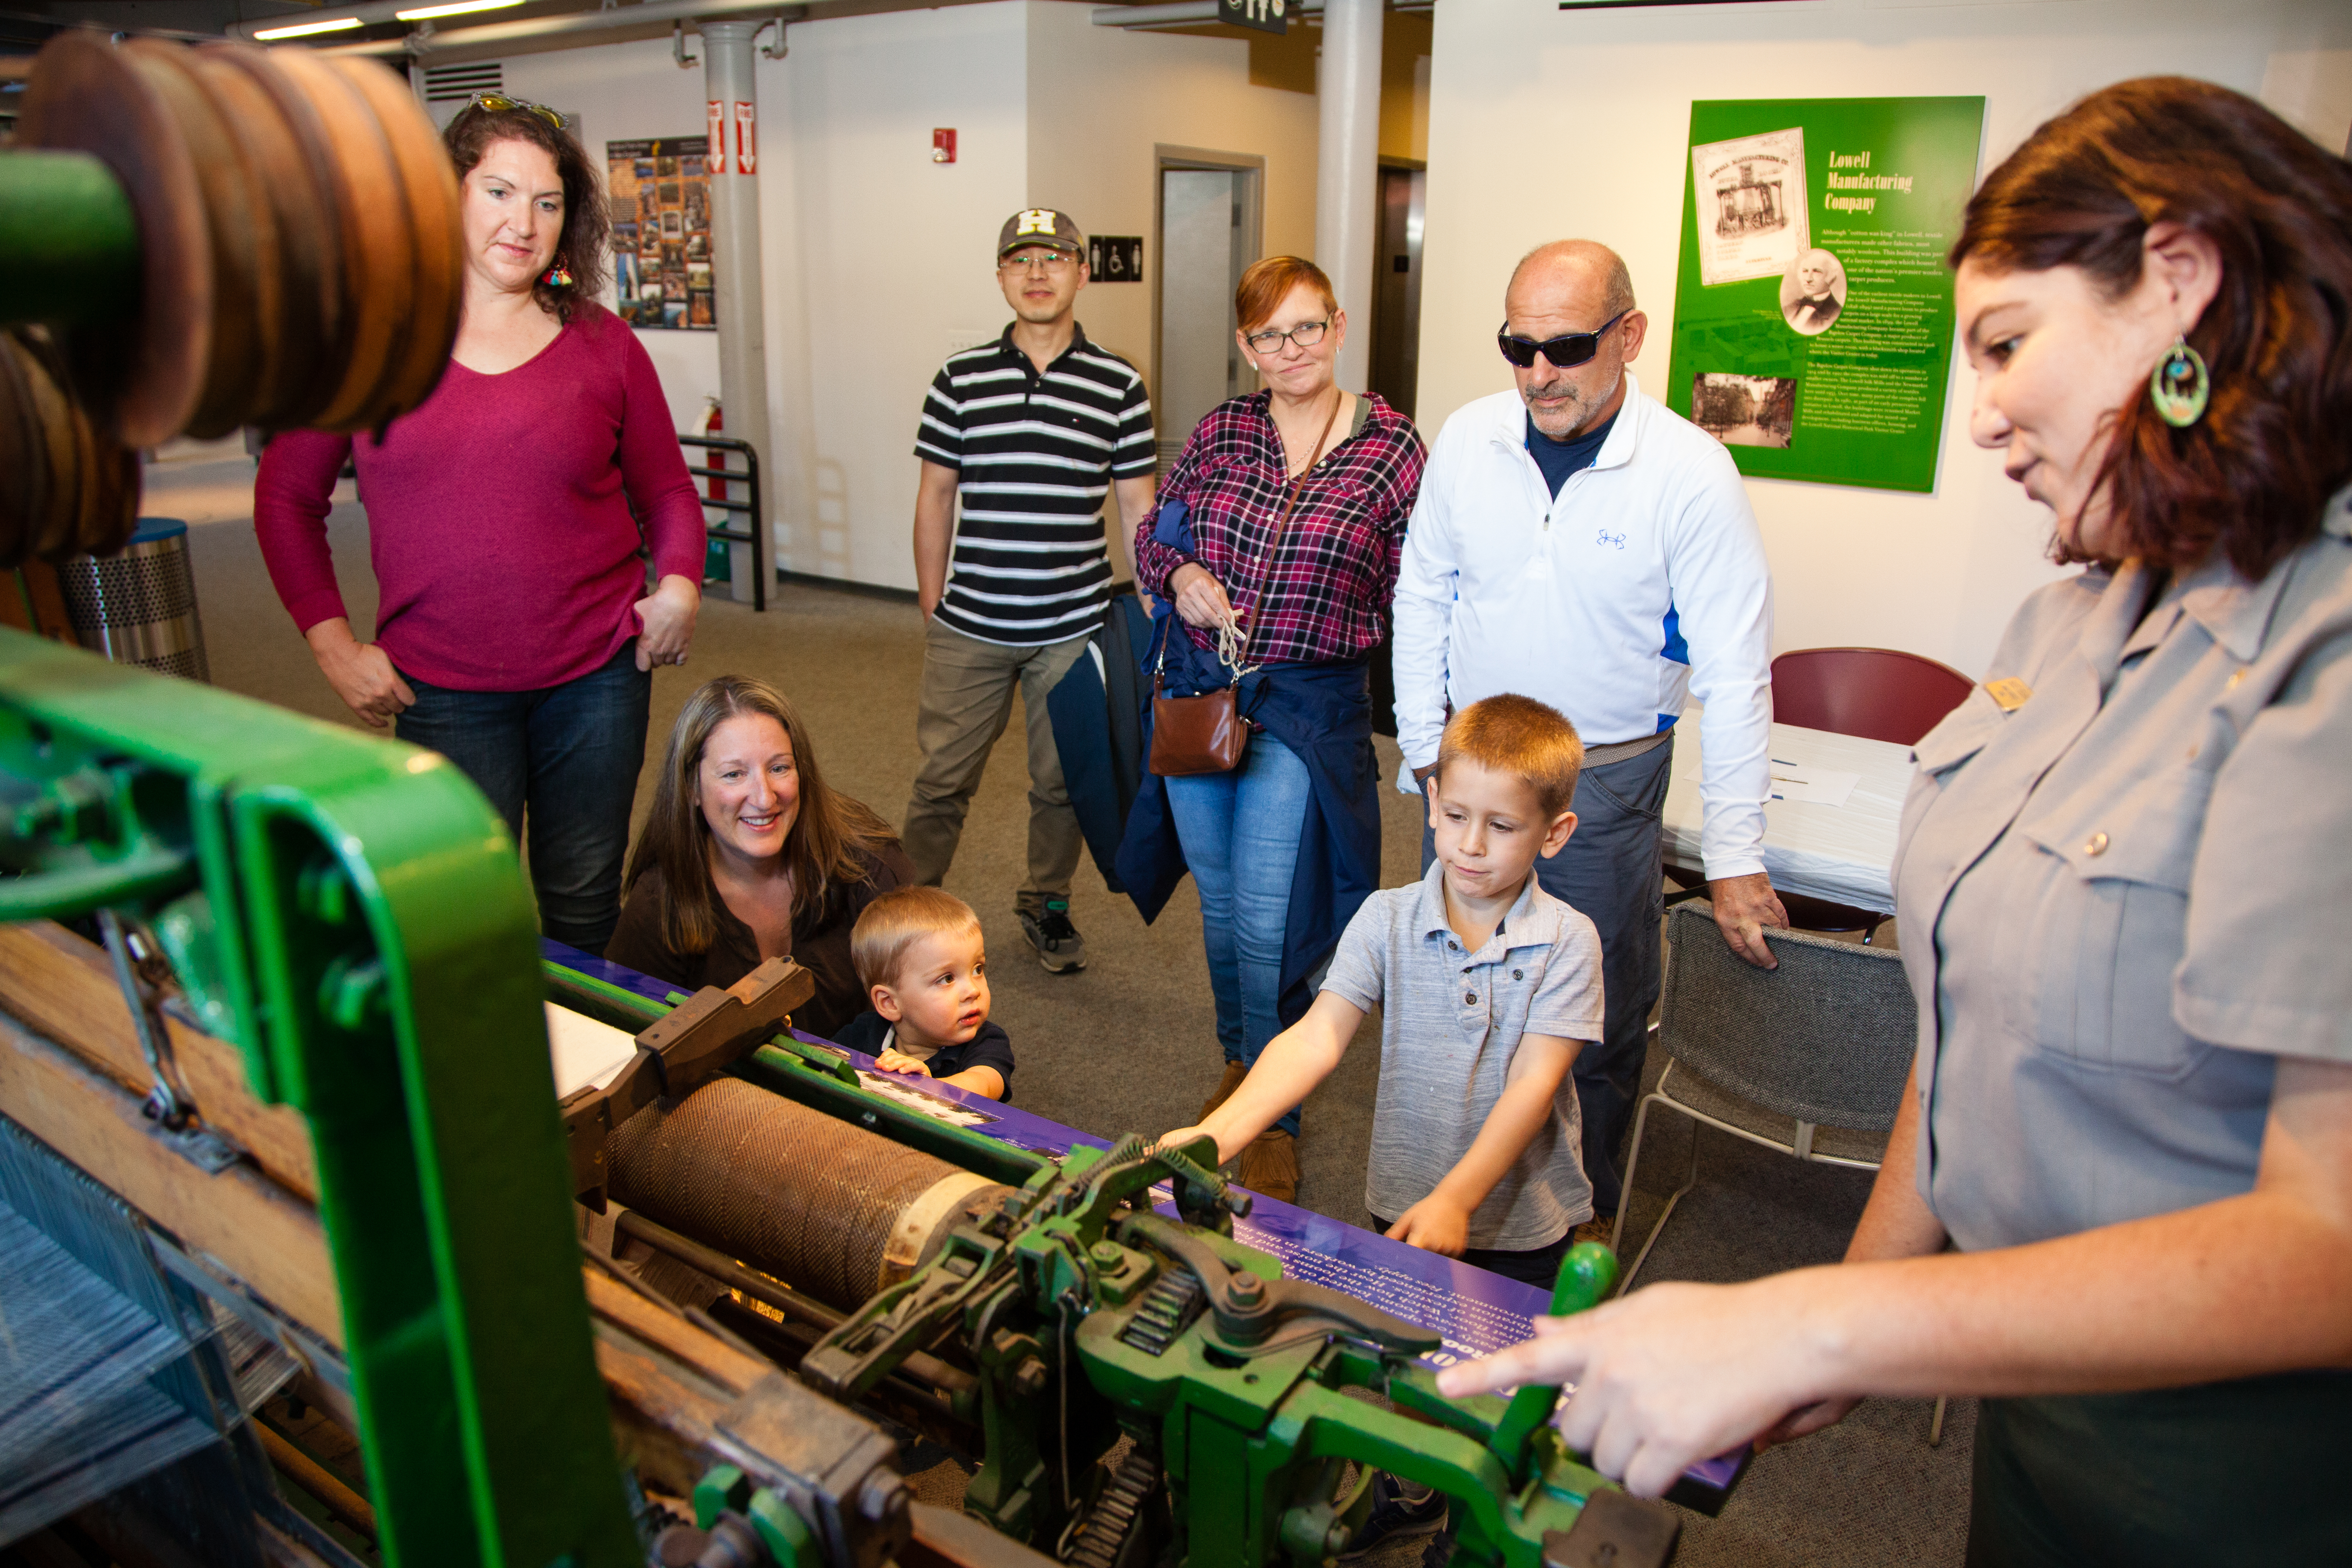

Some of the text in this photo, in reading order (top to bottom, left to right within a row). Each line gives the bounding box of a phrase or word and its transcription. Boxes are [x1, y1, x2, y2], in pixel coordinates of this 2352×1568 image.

[1829, 151, 1870, 168] Lowell
[1826, 172, 1912, 193] Manufacturing
[1825, 192, 1876, 216] Company
[1232, 1230, 1254, 1240] fee
[1255, 1231, 1282, 1243] this
[1249, 1243, 1290, 1259] weave
[1256, 1238, 1283, 1250] and
[1284, 1248, 1322, 1264] noise
[1301, 1247, 1356, 1269] workers
[1279, 1261, 1295, 1270] th
[1292, 1259, 1336, 1277] looms
[1297, 1268, 1317, 1277] on
[1324, 1263, 1348, 1274] the
[1358, 1266, 1376, 1276] by
[1317, 1276, 1371, 1298] located
[1338, 1275, 1362, 1286] the
[1350, 1272, 1386, 1287] Hear
[1415, 1280, 1443, 1293] Fees
[1364, 1284, 1395, 1298] how
[1377, 1273, 1468, 1308] experienced
[1398, 1296, 1442, 1314] Watch
[1447, 1305, 1466, 1315] of
[1423, 1312, 1469, 1331] weave
[1468, 1312, 1534, 1338] patterns
[1470, 1306, 1535, 1331] ibration
[1471, 1329, 1511, 1346] 920s
[1438, 1338, 1492, 1361] Roo
